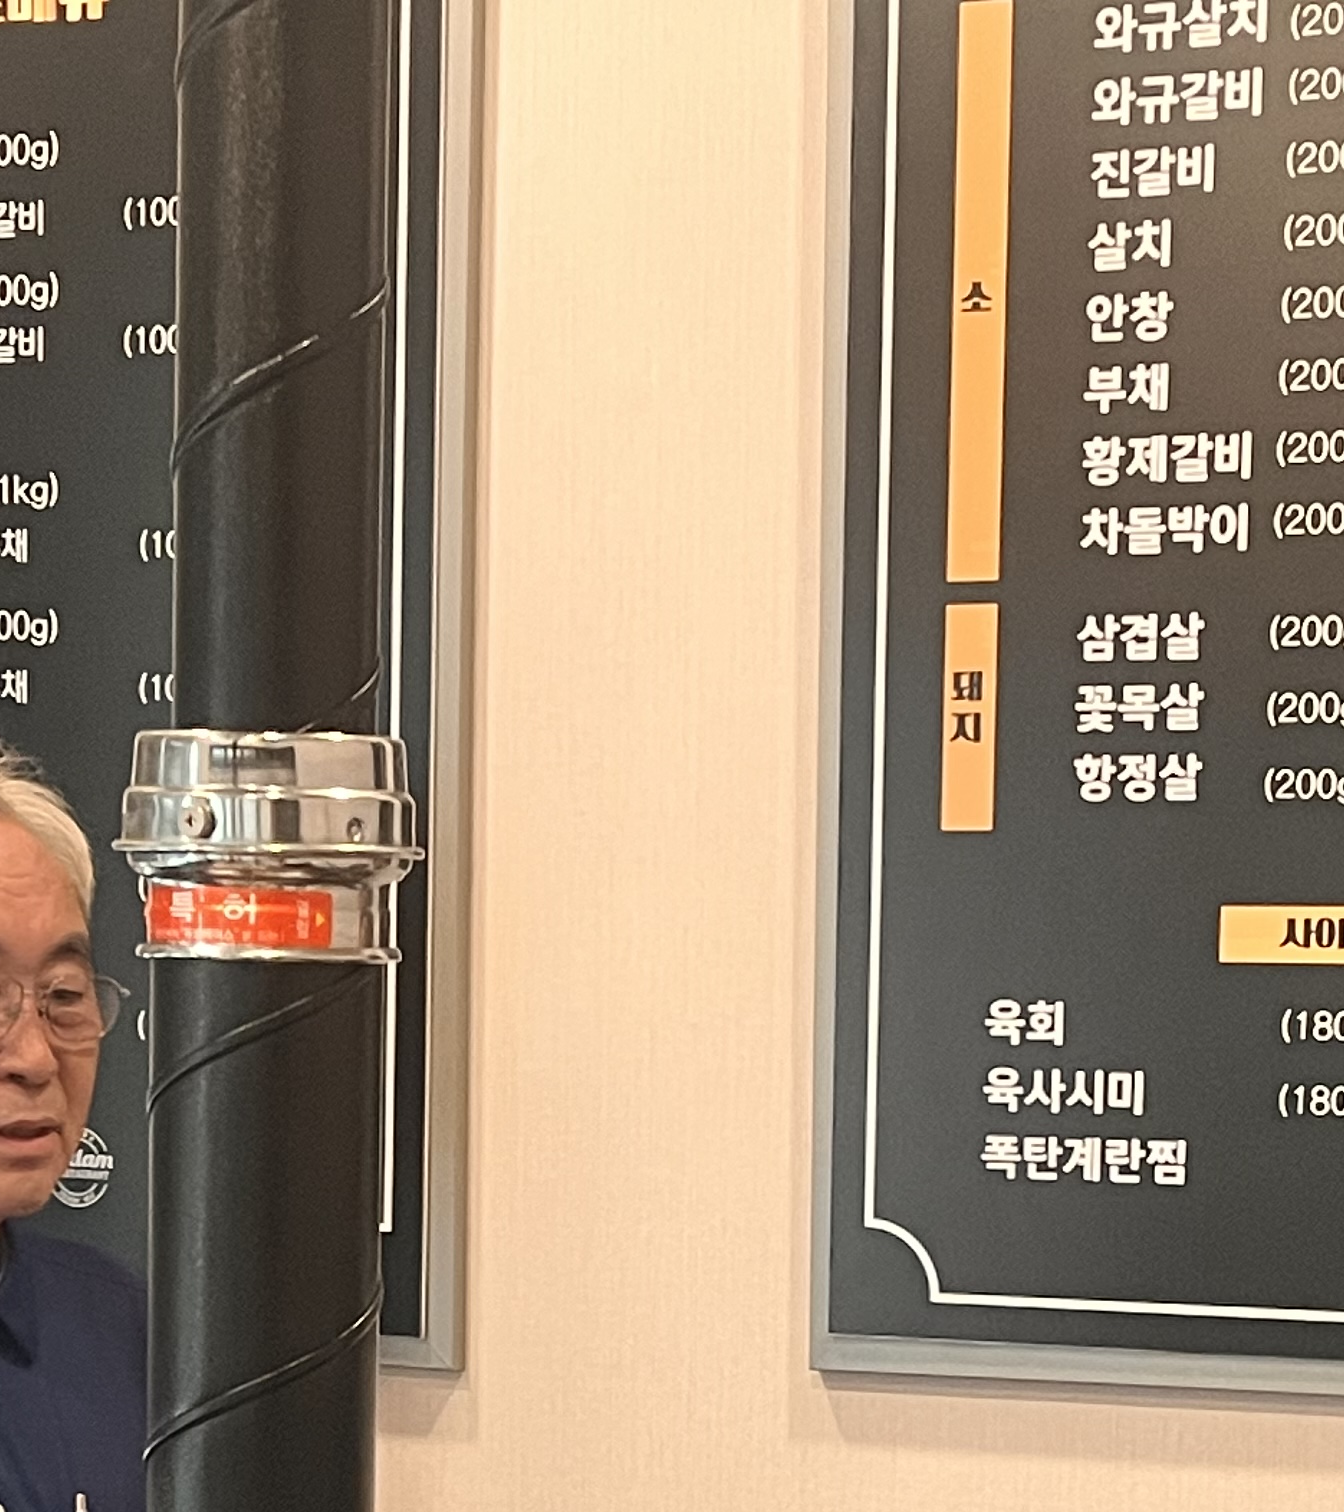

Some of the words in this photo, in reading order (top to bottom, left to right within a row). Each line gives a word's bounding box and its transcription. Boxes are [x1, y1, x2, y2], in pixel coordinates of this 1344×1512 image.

[1091, 66, 1264, 126] 와규갈비
[1090, 142, 1215, 199] 진갈비
[1087, 218, 1172, 272] 살치
[961, 281, 992, 313] 소
[1086, 290, 1174, 343] 안창
[1082, 362, 1170, 415] 부채
[1082, 430, 1253, 487] 황제갈비
[1079, 502, 1249, 556] 차돌박이
[1076, 611, 1206, 662] 삼겹살
[950, 670, 983, 743] 돼지
[1074, 682, 1205, 733] 꽃목살
[1073, 752, 1203, 803] 항정살
[984, 999, 1065, 1046] 육회
[982, 1067, 1145, 1116] 육사시미
[980, 1134, 1187, 1186] 폭탄계란찜
